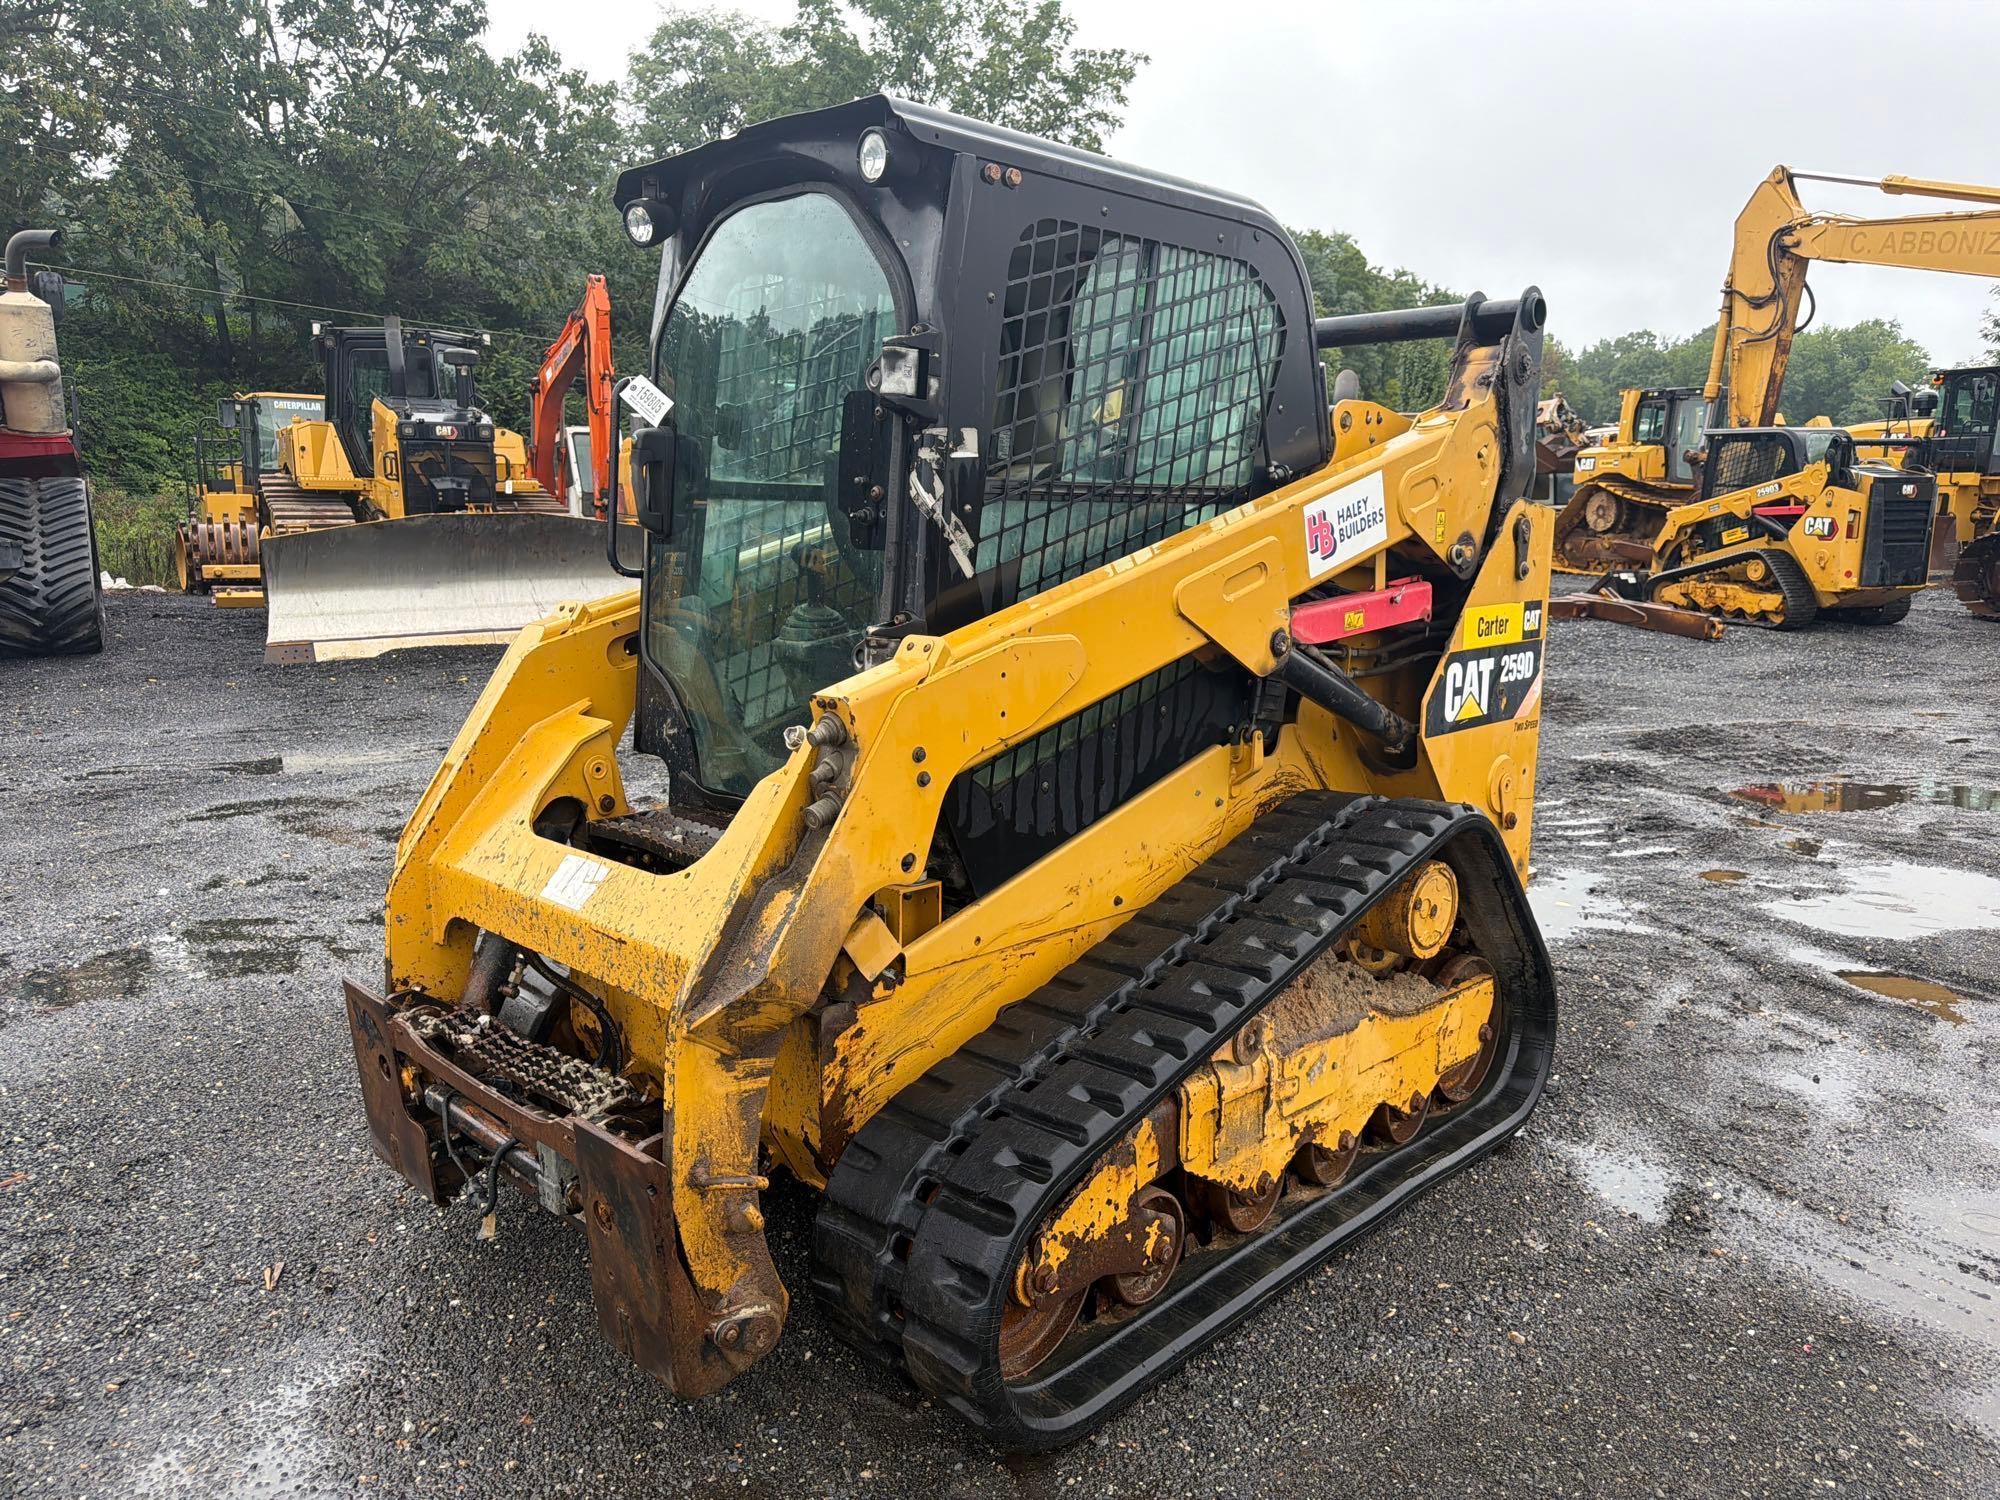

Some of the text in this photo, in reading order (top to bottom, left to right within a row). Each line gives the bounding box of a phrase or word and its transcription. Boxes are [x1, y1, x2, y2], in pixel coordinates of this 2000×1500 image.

[1850, 231, 1871, 254] C.
[273, 400, 321, 411] CATERPILLAR
[636, 385, 665, 414] 159805
[435, 425, 453, 436] CAT
[1902, 484, 1914, 495] CAT
[1337, 496, 1368, 525] HALEY
[1338, 507, 1384, 543] BUILDERS
[1804, 517, 1832, 536] CAT
[1477, 609, 1541, 637] Carter CAT
[1444, 651, 1535, 722] CAT 259D
